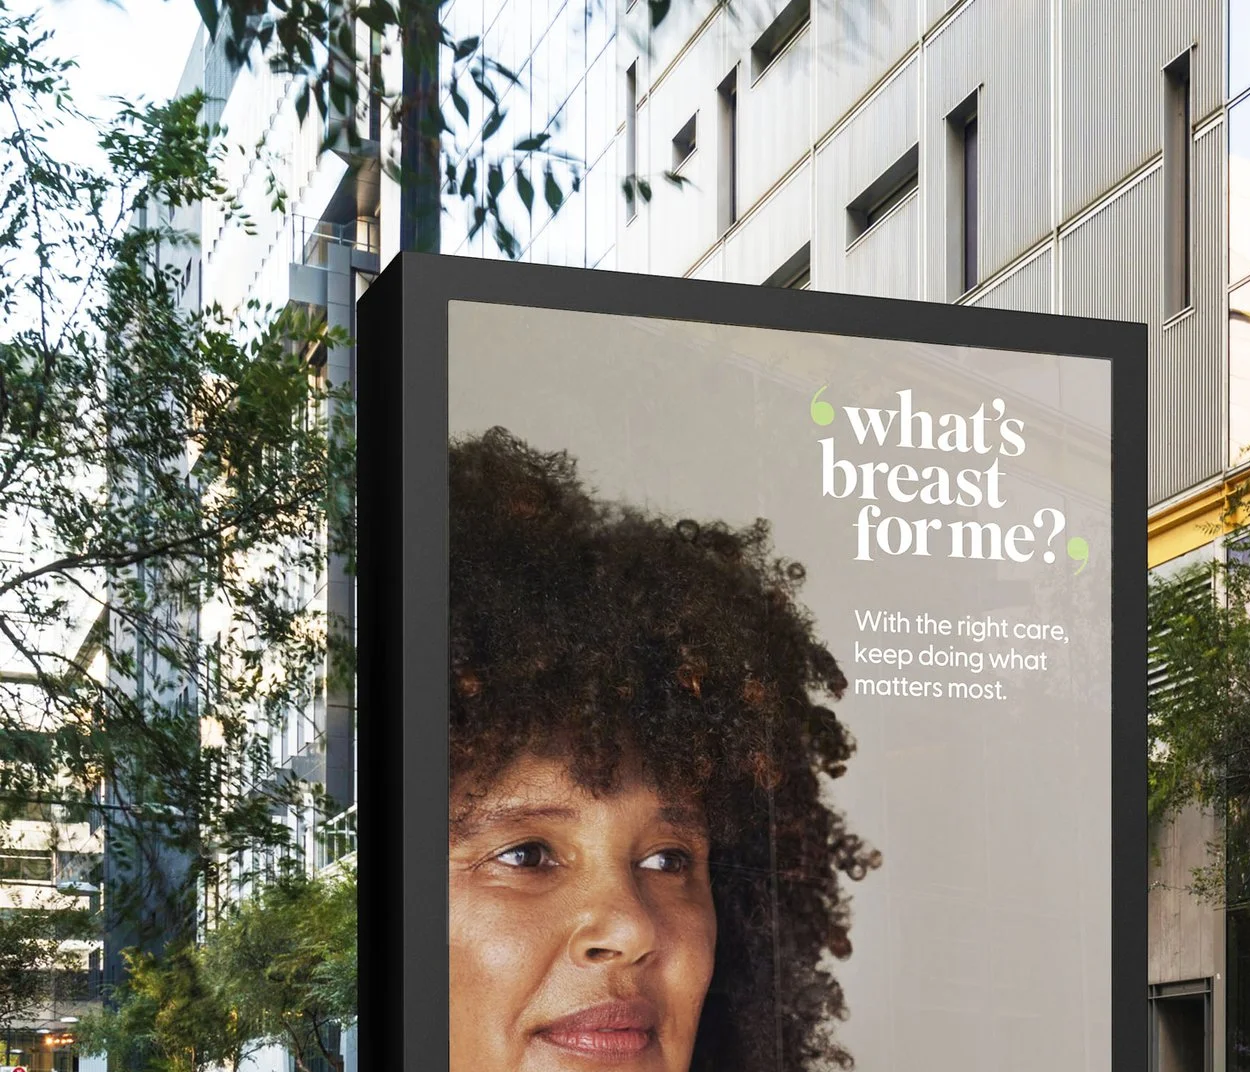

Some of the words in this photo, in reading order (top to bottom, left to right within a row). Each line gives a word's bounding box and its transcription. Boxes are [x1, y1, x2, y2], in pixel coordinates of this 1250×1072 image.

[818, 437, 1007, 508] breast
[852, 504, 942, 561] for
[854, 609, 910, 634] With
[916, 613, 952, 636] the
[957, 615, 1008, 642] right
[1013, 621, 1069, 644] care,
[854, 641, 913, 670] keep
[918, 645, 984, 673] doing
[989, 648, 1047, 671] what
[854, 676, 942, 698] matters
[948, 680, 1007, 700] most.
